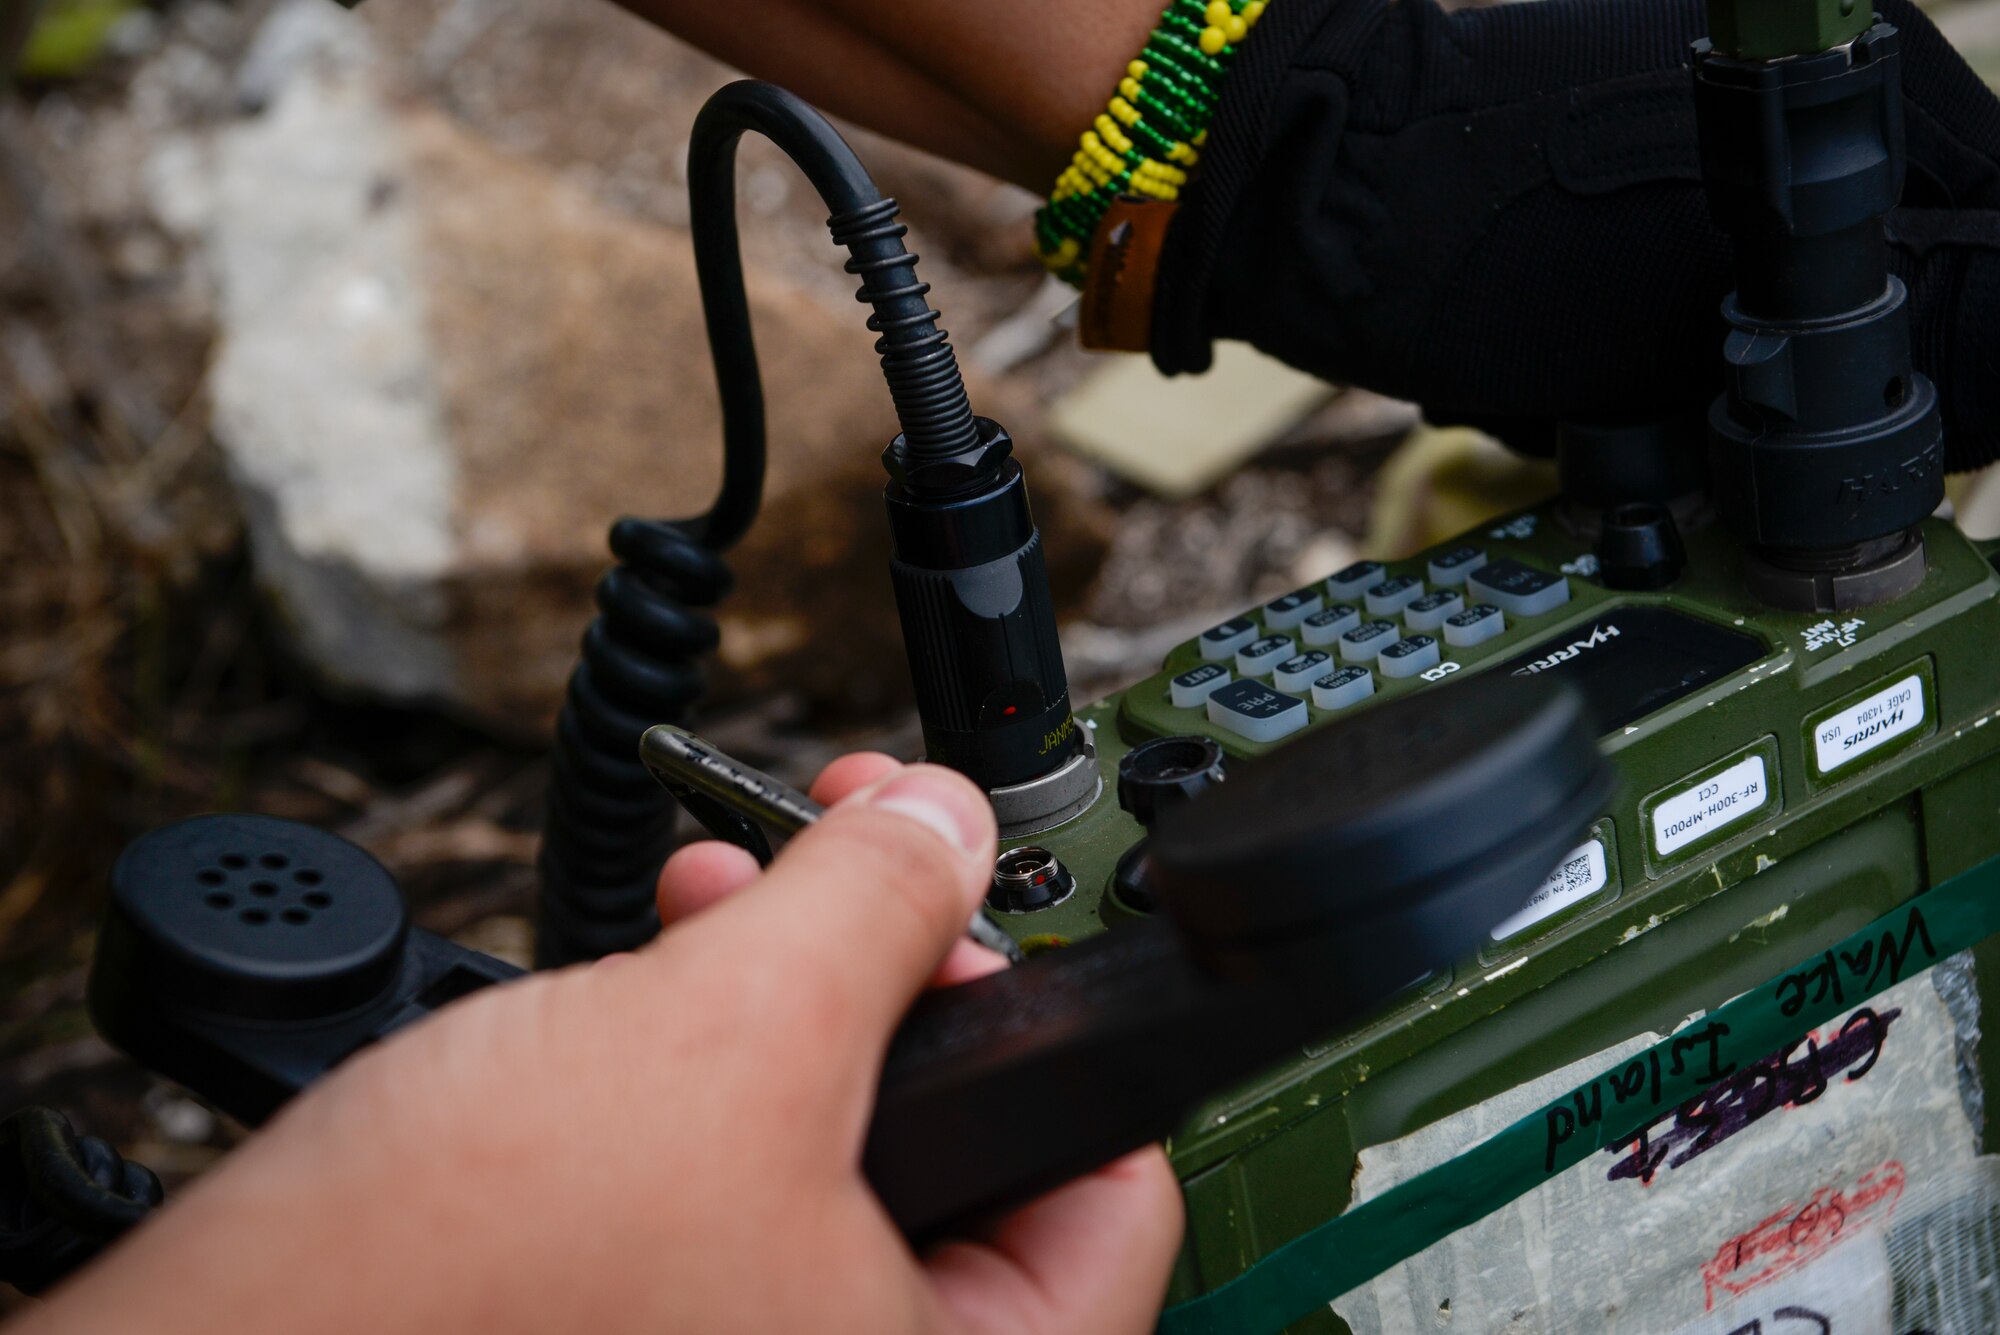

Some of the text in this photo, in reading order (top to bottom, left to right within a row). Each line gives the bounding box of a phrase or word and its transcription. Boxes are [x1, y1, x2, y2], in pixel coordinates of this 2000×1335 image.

[1183, 666, 1218, 685] ENT
[1420, 662, 1461, 682] CCI
[1236, 692, 1276, 711] PRE
[1820, 688, 1911, 744] CAGE 14304 USA
[1842, 708, 1904, 750] HARRIS
[1698, 783, 1719, 802] CCI
[1663, 782, 1758, 839] RF-300H-MP001
[1544, 906, 1935, 1174] Wake Island
